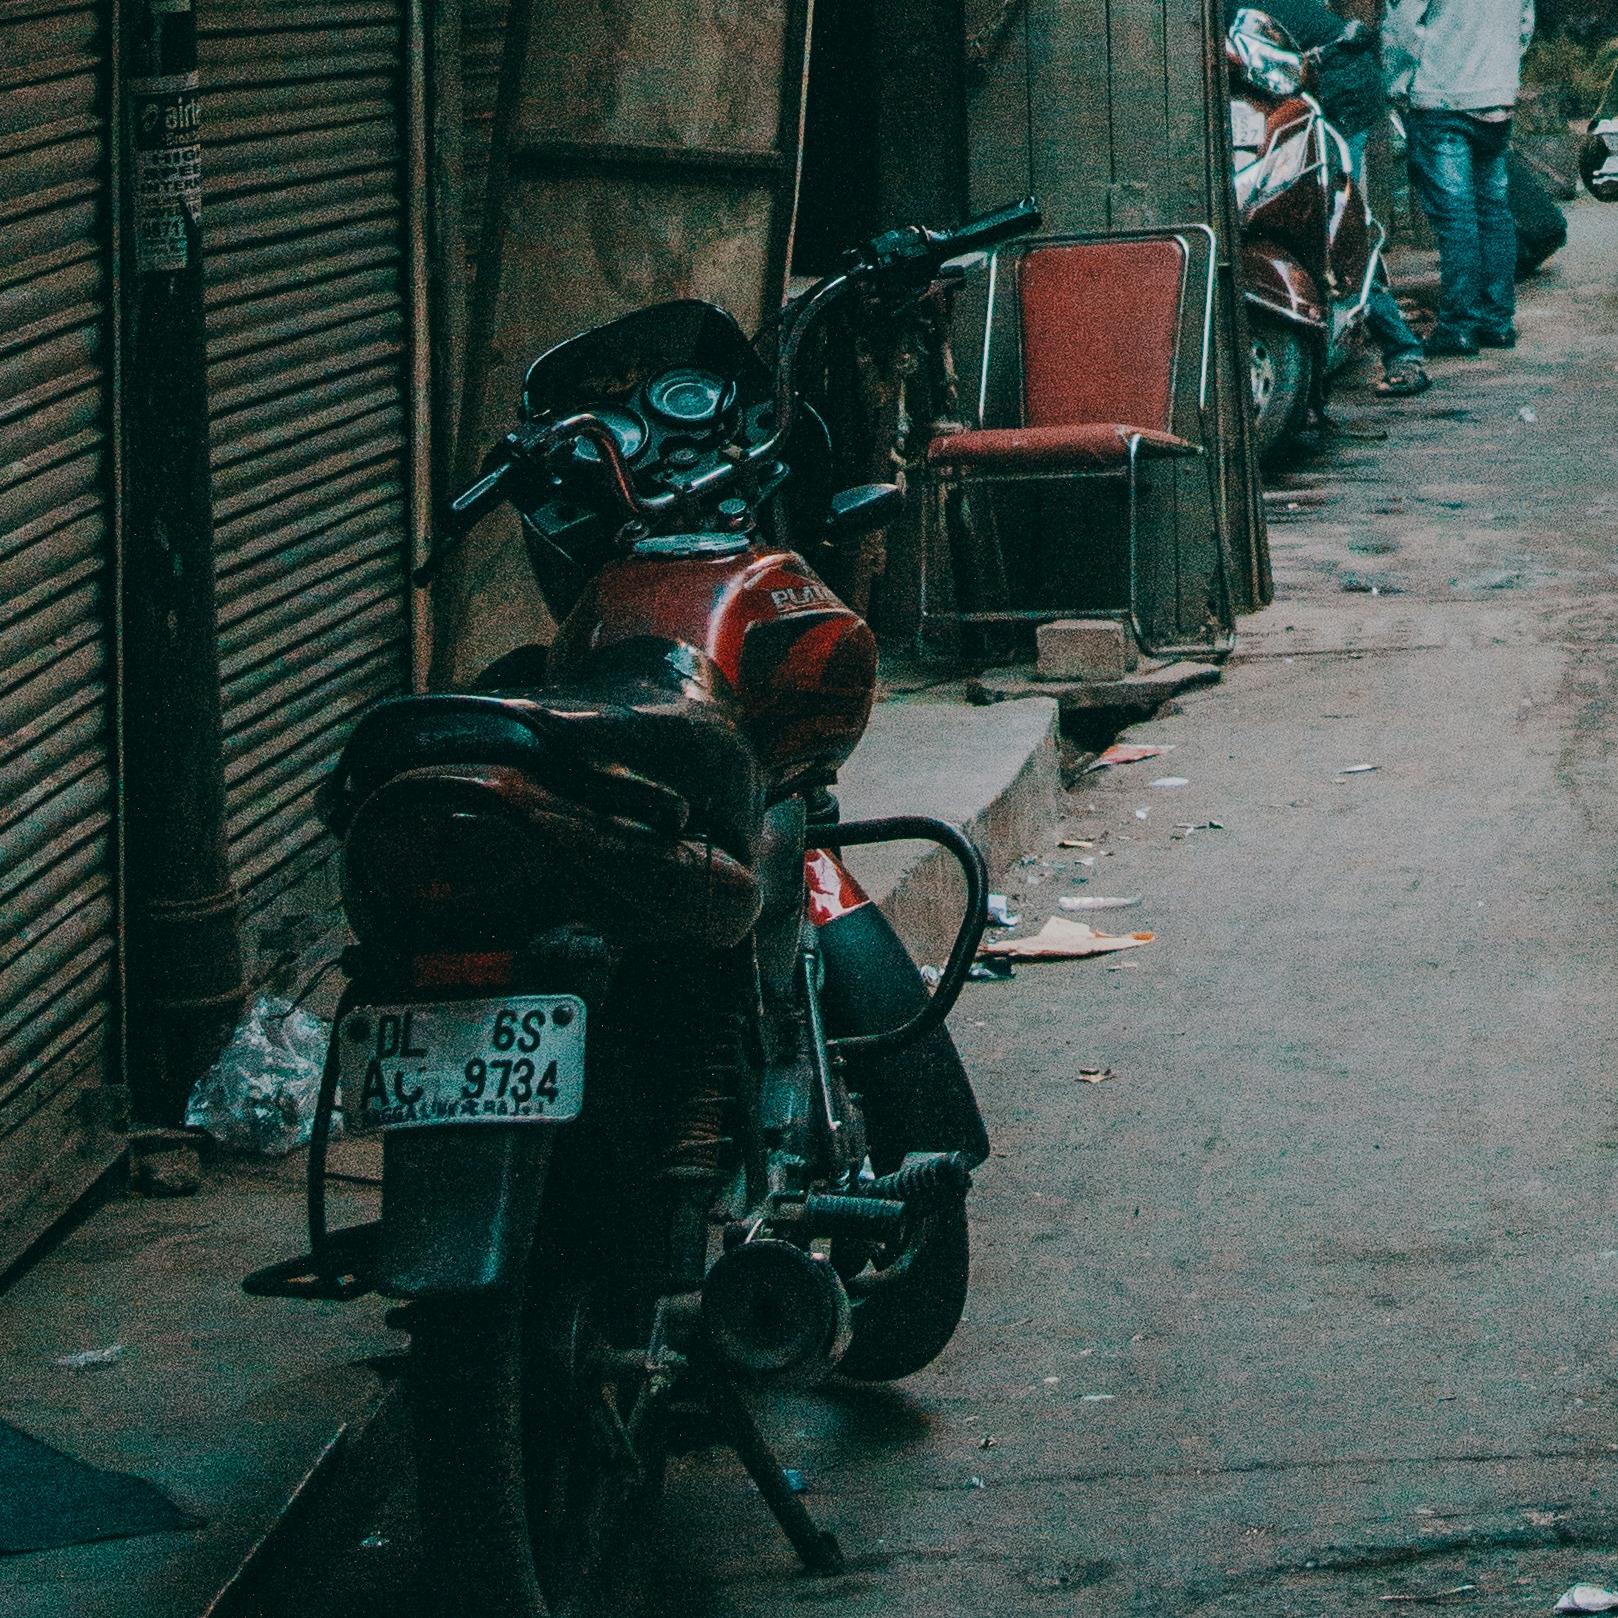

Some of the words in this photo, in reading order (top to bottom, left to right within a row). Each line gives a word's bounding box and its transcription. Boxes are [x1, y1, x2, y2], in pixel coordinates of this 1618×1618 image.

[377, 1012, 428, 1058] DL
[493, 1008, 547, 1054] 6S
[461, 1056, 560, 1105] 9734
